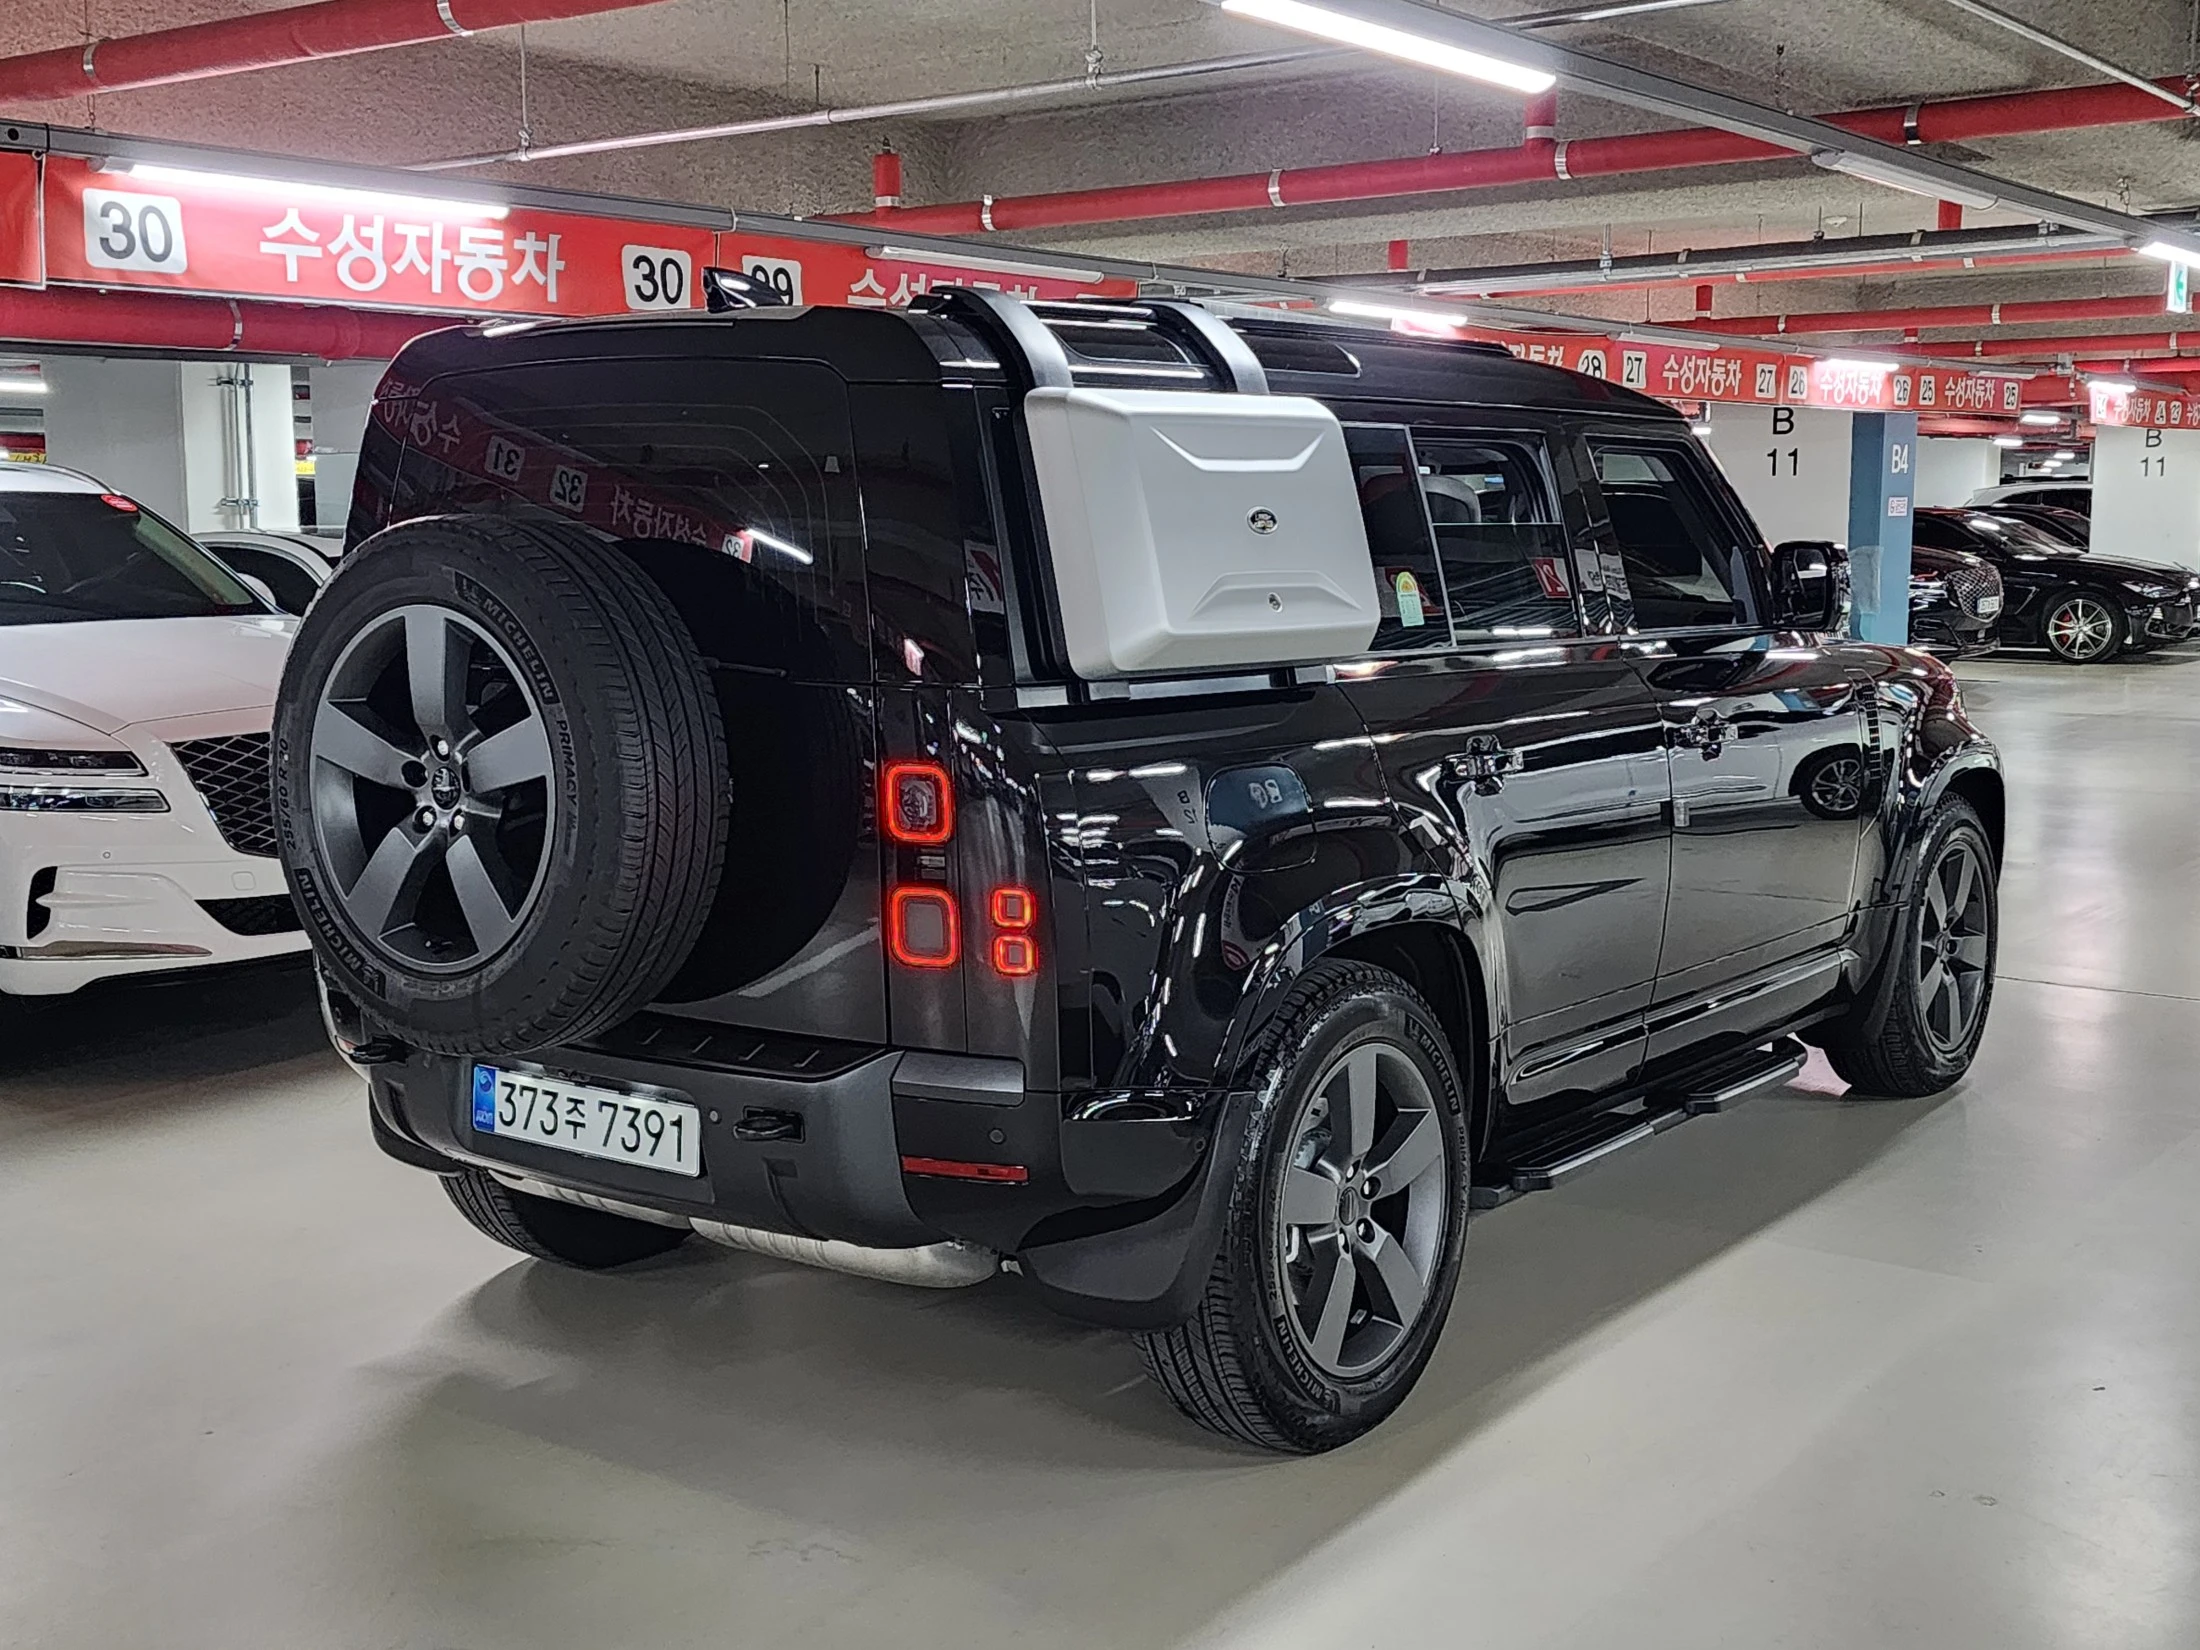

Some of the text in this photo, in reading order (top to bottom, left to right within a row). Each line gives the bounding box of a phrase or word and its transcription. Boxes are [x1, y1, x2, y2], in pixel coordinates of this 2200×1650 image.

[99, 200, 173, 263] 30
[259, 207, 566, 303] 수성자동차
[633, 254, 684, 305] 30
[1626, 355, 1643, 384] 27
[1662, 354, 1742, 397] 수성자동차
[1758, 367, 1774, 394] 27
[1790, 369, 1805, 396] 26
[1819, 367, 1884, 405] 수성자동차
[1895, 378, 1909, 402] 26
[1921, 379, 1934, 402] 25
[1944, 376, 1996, 409] 수성자동차
[2005, 385, 2017, 407] 25
[1772, 407, 1795, 435] B
[2145, 428, 2162, 448] B
[1766, 447, 1799, 477] 11
[1891, 443, 1909, 474] B4
[2140, 456, 2165, 477] 11
[482, 597, 555, 700] MICHELIN
[556, 718, 578, 807] PRIMACY
[279, 785, 297, 851] 255/60
[298, 873, 362, 972] MICHELIN
[1419, 1033, 1459, 1112] MICHELIN
[1276, 1321, 1324, 1400] MICHELIN
